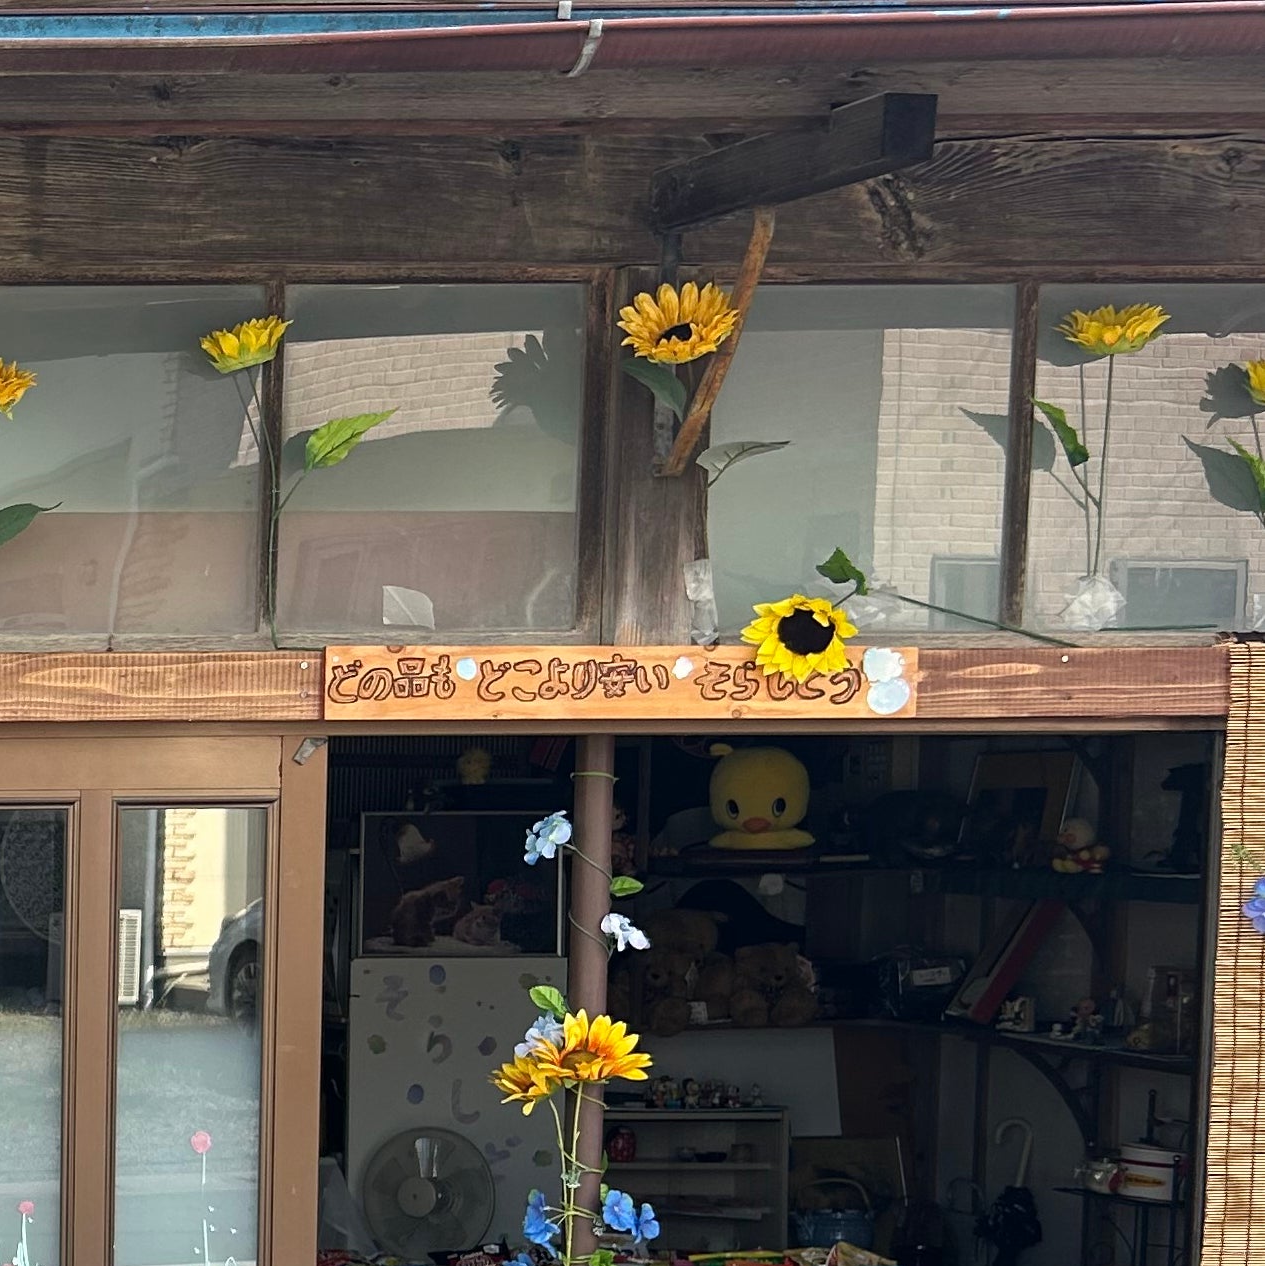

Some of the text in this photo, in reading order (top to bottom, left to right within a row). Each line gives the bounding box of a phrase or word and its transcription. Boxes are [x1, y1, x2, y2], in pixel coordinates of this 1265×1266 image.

[327, 654, 456, 704] どの品も
[477, 653, 670, 702] どこより安い
